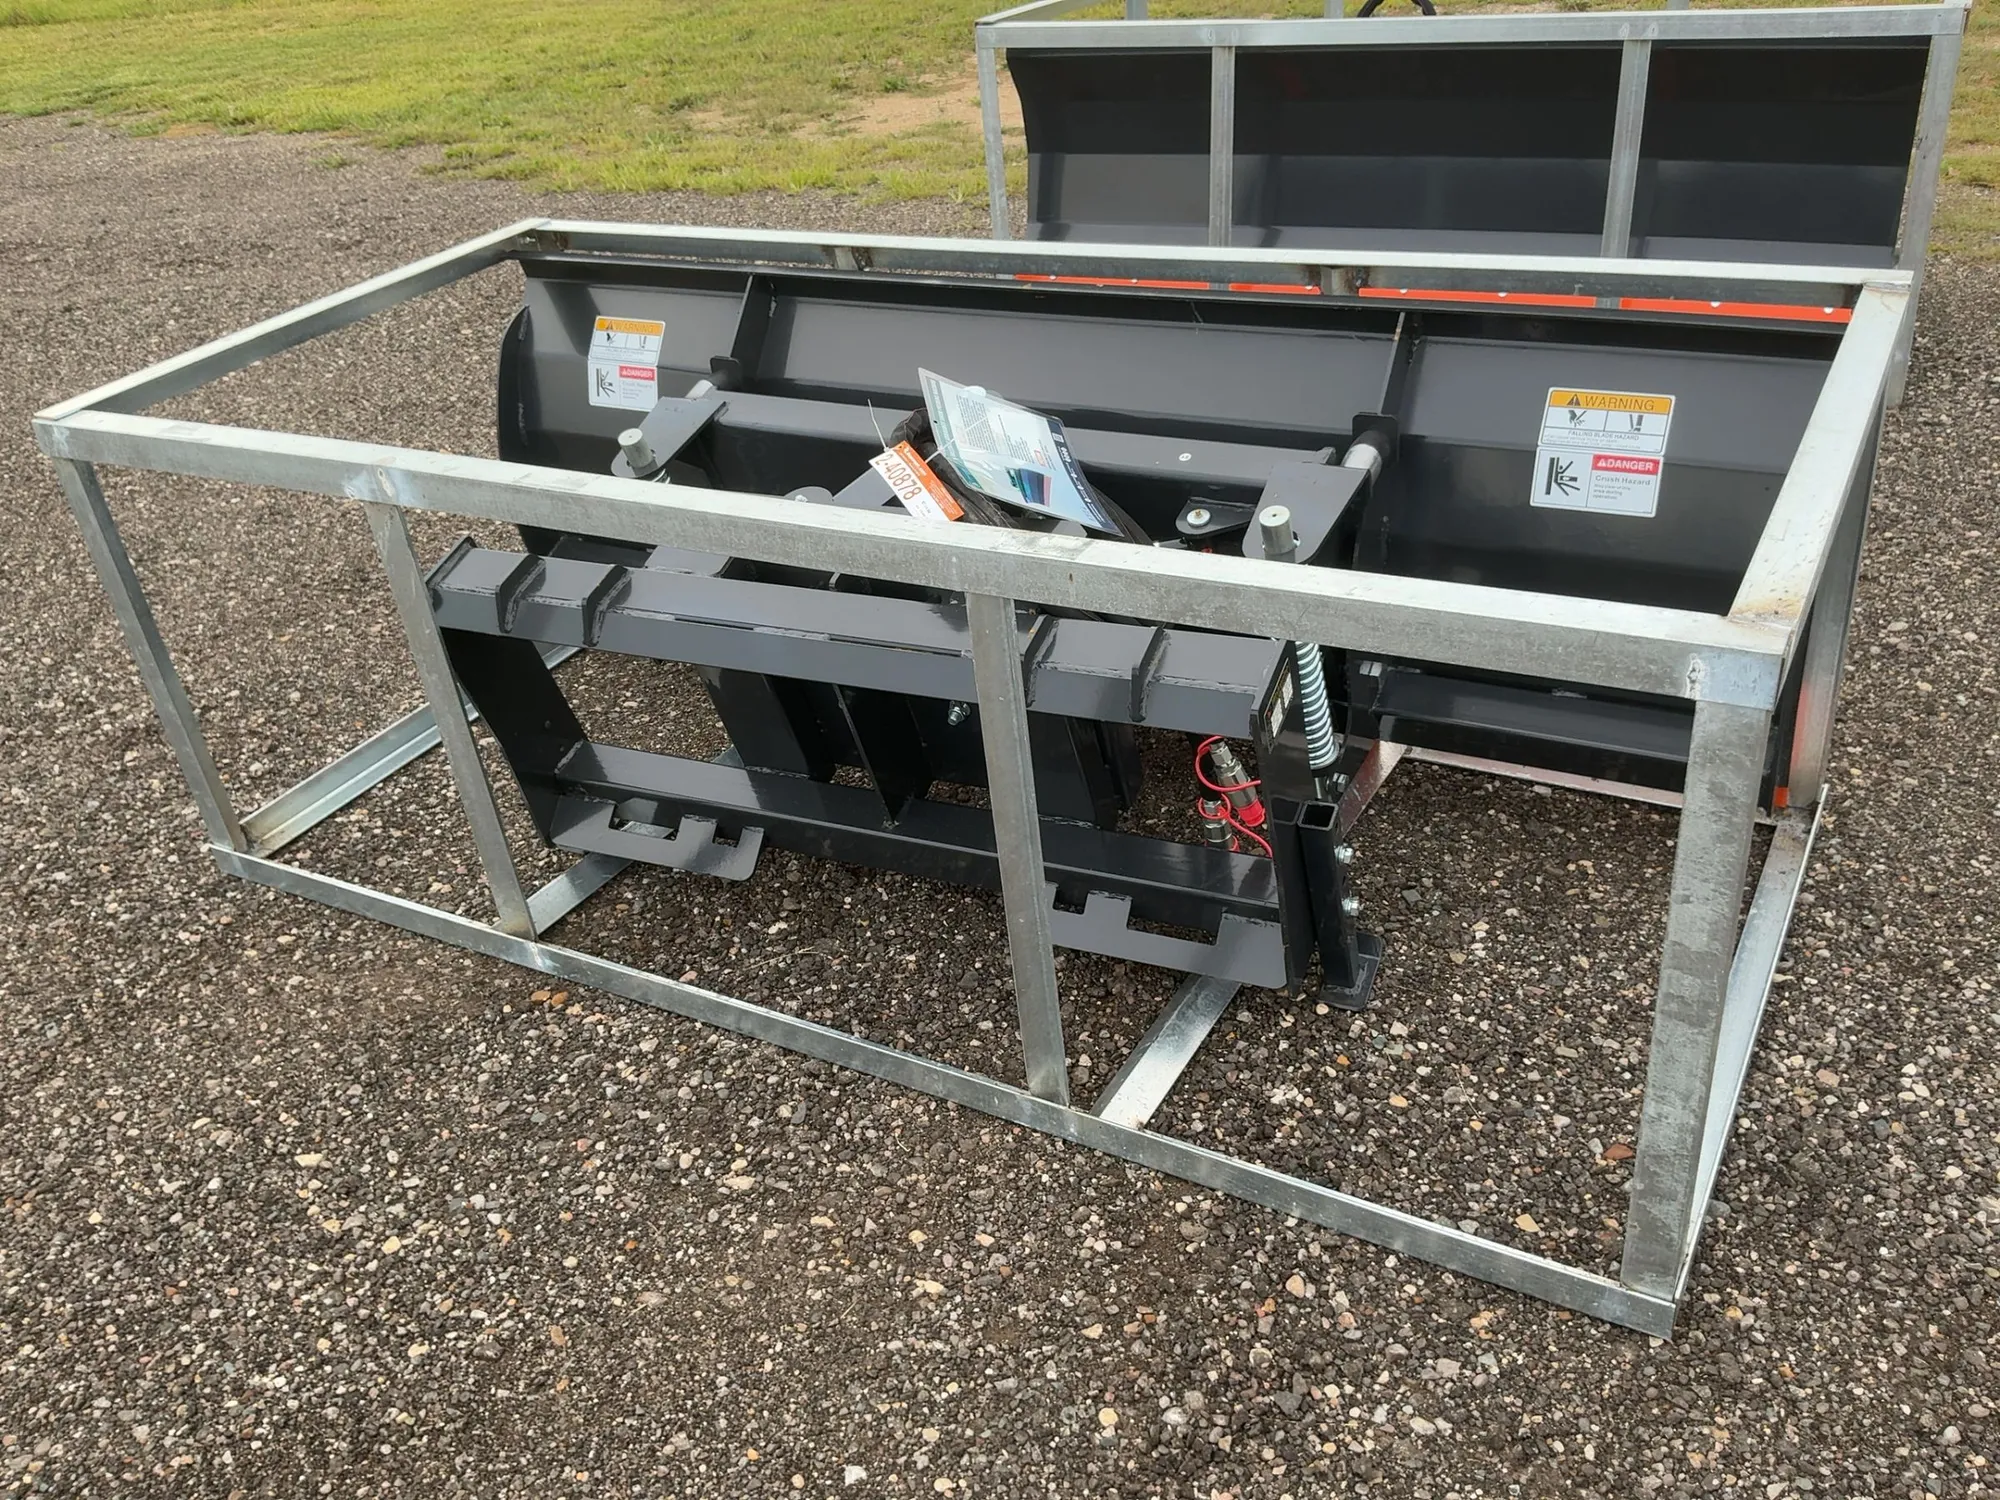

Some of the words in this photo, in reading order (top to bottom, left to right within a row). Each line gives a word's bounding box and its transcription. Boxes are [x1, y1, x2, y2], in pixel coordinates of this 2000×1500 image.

[615, 322, 655, 333] WARNING
[626, 370, 653, 379] DANGER
[1584, 395, 1655, 411] WARNING
[1613, 433, 1640, 441] HAZARD
[1607, 458, 1653, 471] DANGER
[1595, 475, 1620, 483] Crush
[1621, 477, 1651, 486] Hazard
